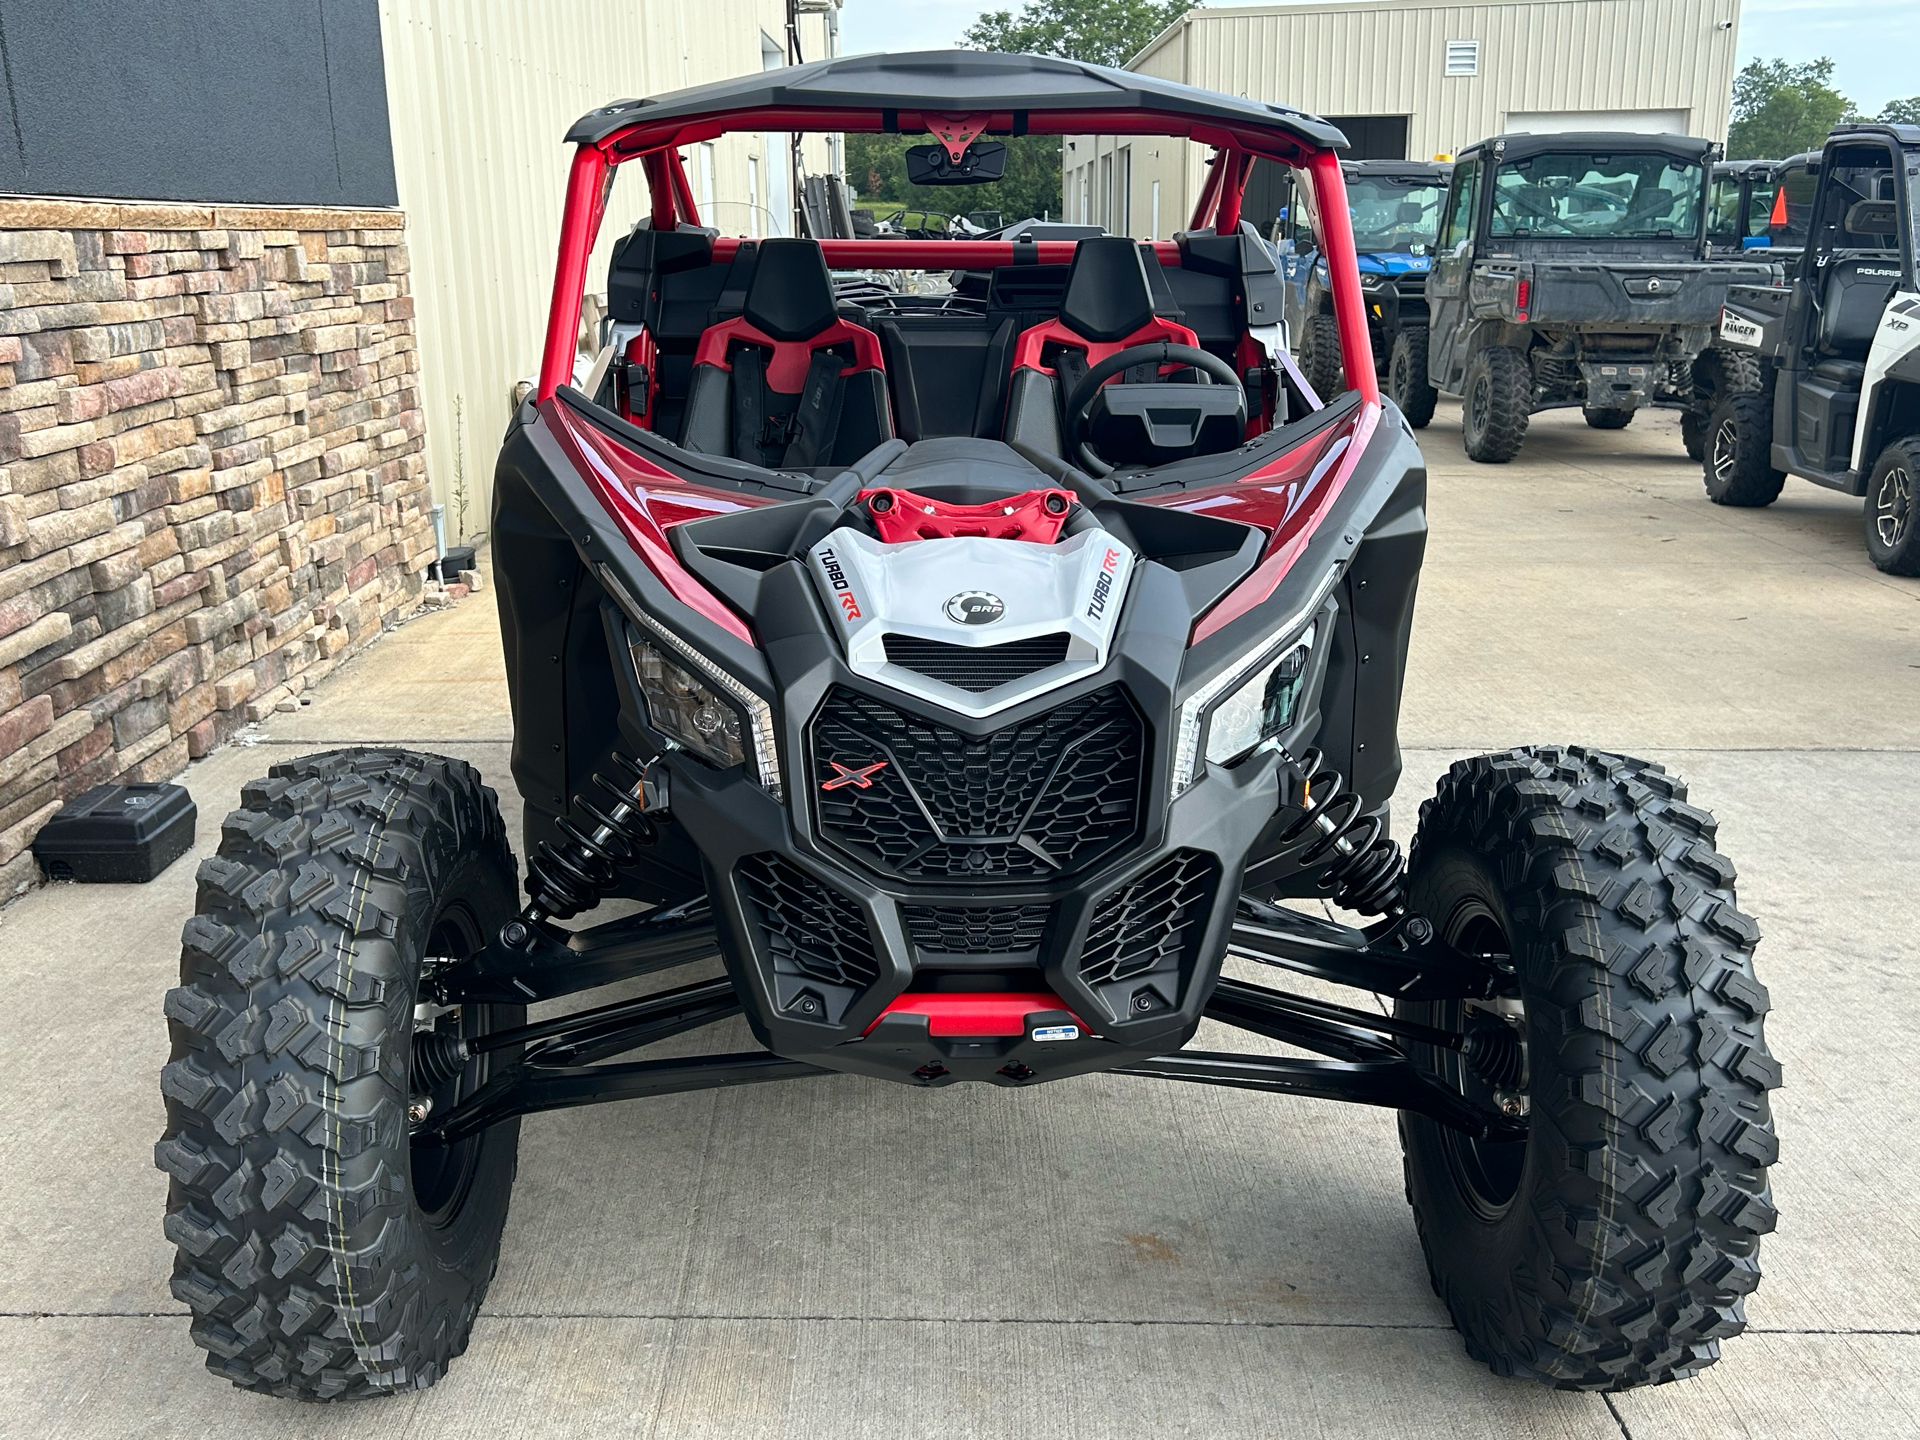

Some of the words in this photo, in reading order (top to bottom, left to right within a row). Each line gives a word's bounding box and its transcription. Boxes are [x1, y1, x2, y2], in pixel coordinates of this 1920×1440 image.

[1857, 267, 1902, 277] POLARIS
[1724, 322, 1756, 337] RANGER
[1886, 318, 1909, 331] XP
[819, 548, 849, 590] TURBO
[838, 591, 861, 621] RR
[1087, 571, 1112, 621] TURBO
[1102, 548, 1120, 574] RR
[970, 605, 1003, 613] BRP
